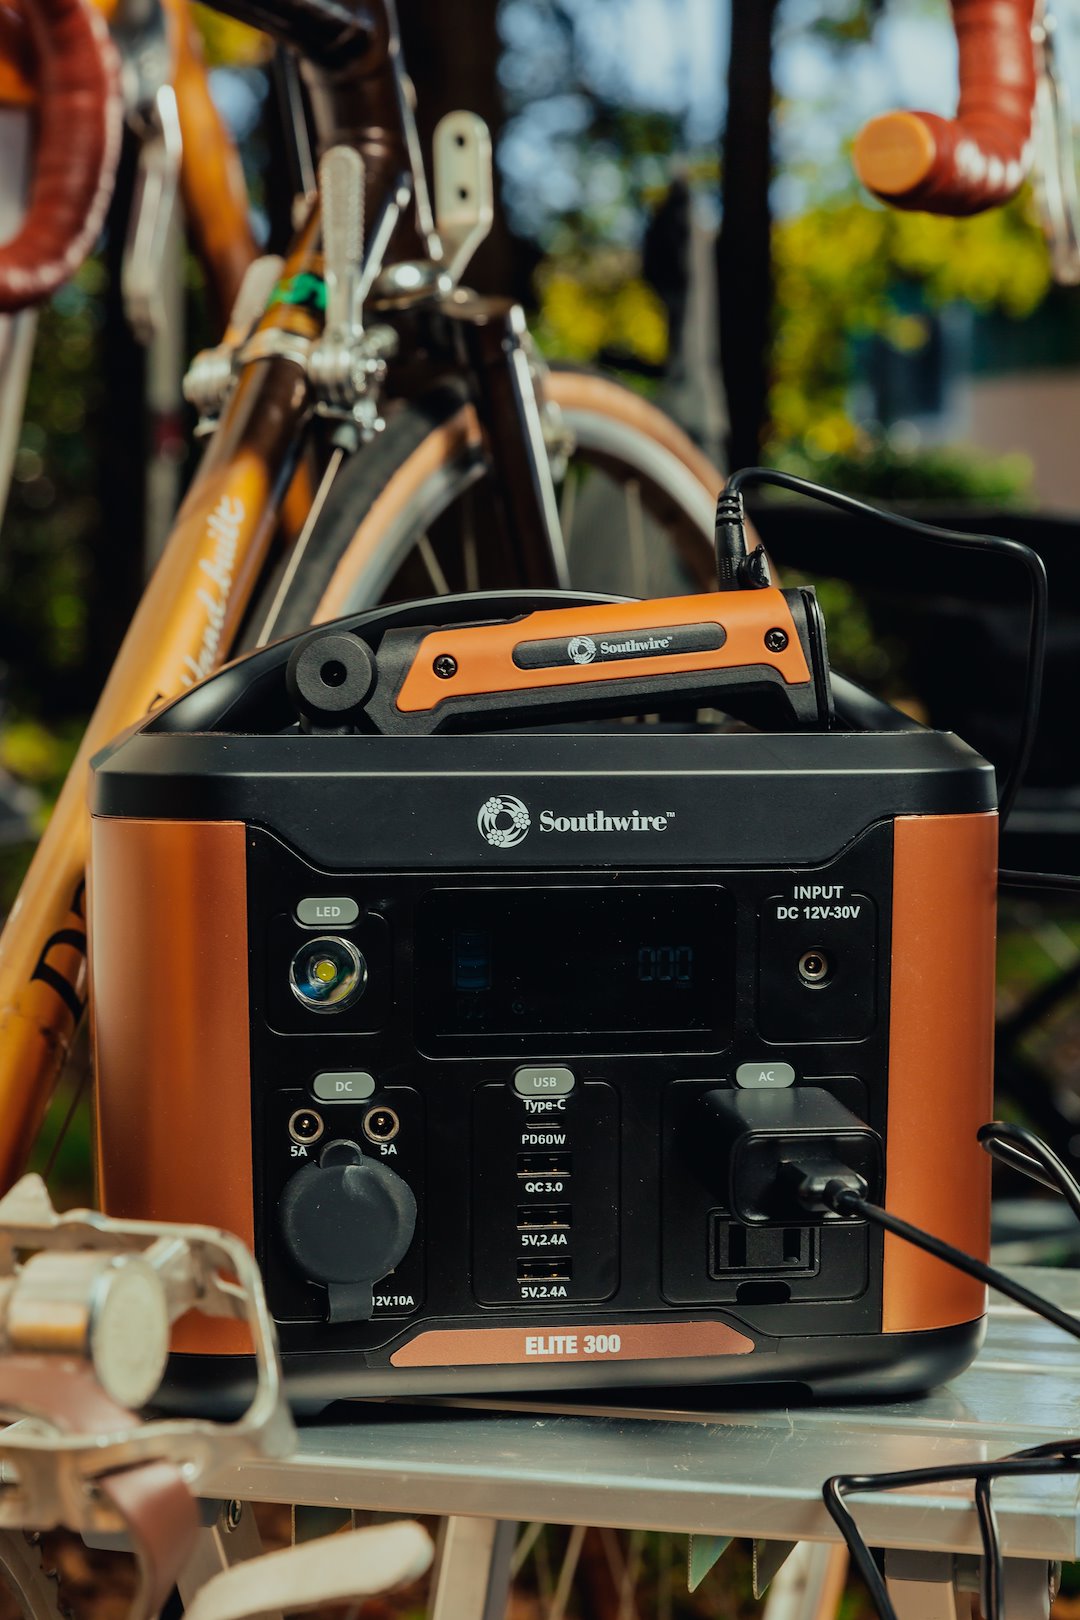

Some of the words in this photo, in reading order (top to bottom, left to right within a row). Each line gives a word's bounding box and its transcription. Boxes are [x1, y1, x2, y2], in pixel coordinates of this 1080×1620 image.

[793, 885, 844, 900] INPUT
[316, 906, 341, 917] LED
[776, 906, 799, 920] DC
[803, 905, 861, 920] 12V-30V
[533, 1077, 557, 1088] USB
[758, 1071, 775, 1082] AC
[335, 1081, 353, 1092] DC
[523, 1099, 567, 1114] Type-C
[521, 1134, 566, 1145] PD60W
[290, 1145, 309, 1157] 5A
[380, 1144, 398, 1156] 5A
[521, 1233, 568, 1247] 5V,2.4A
[521, 1285, 568, 1299] 5V,2.4A
[525, 1335, 578, 1356] ELITE
[583, 1334, 621, 1354] 300
